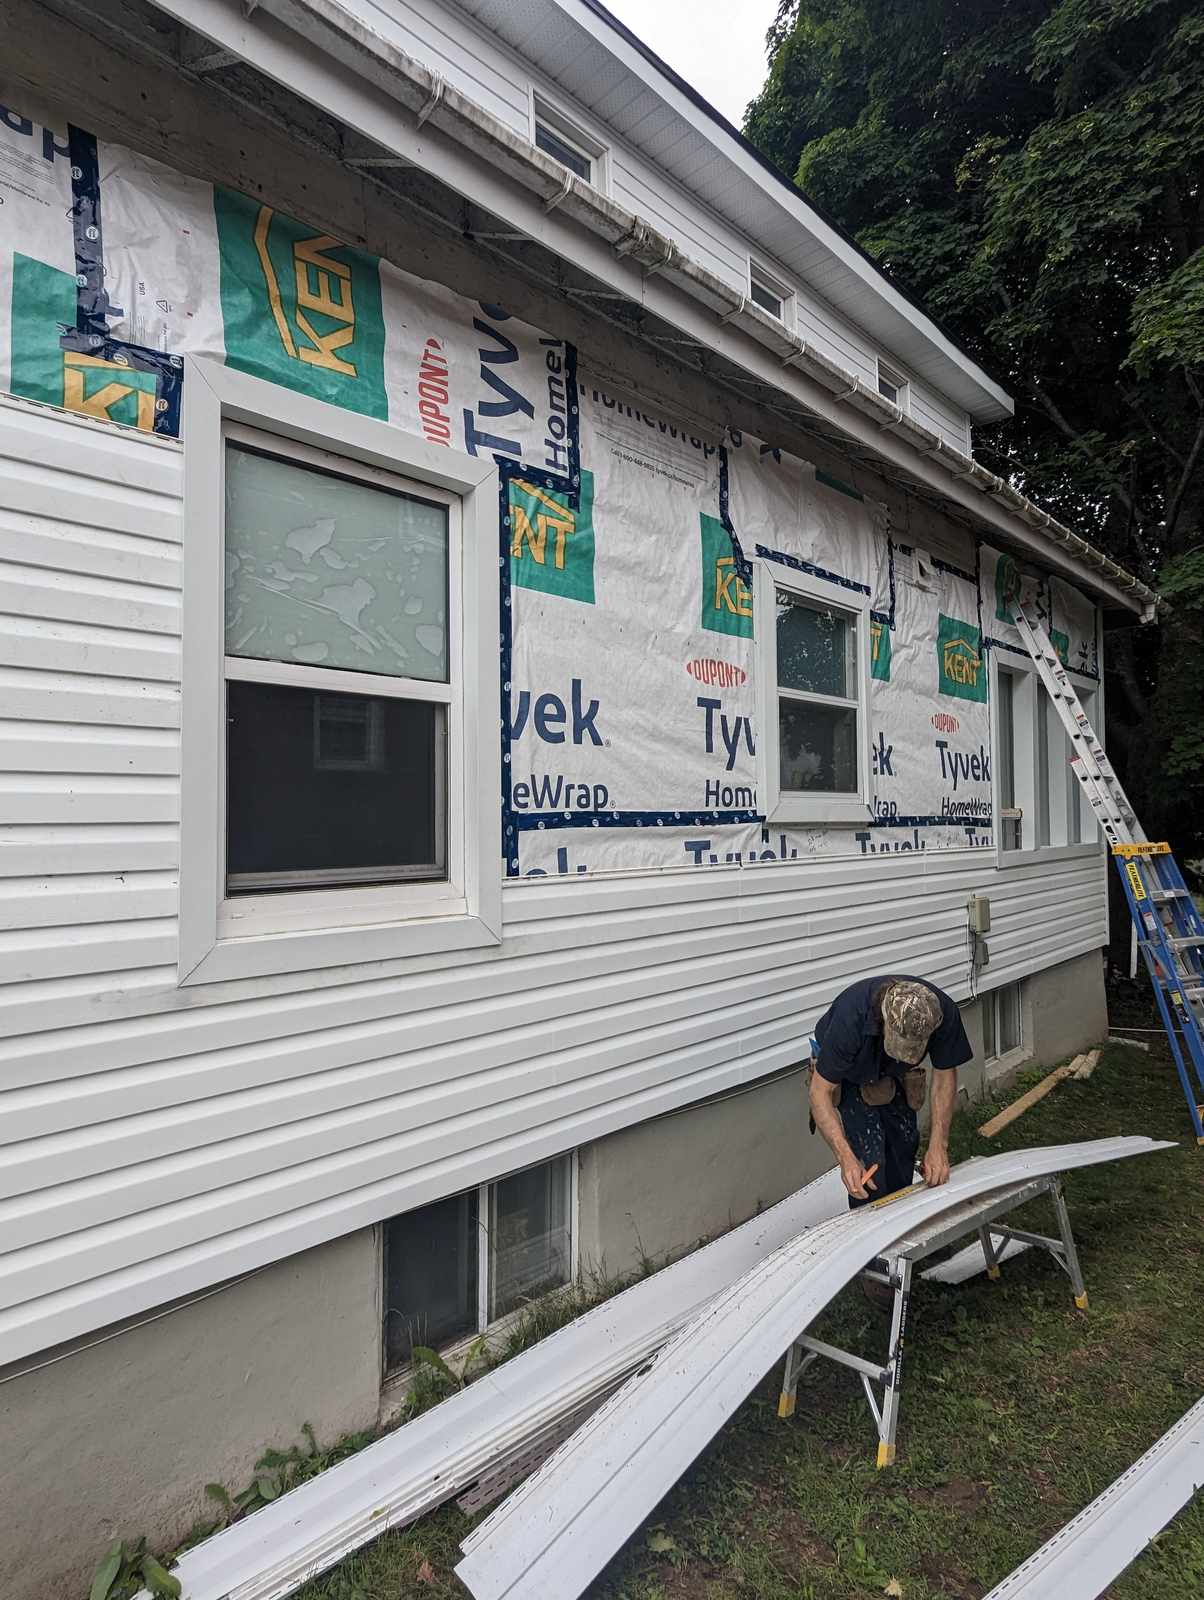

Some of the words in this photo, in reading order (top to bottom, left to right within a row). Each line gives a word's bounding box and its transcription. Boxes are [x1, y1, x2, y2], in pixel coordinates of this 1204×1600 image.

[463, 300, 534, 457] Tyv
[539, 338, 568, 473] Home
[509, 504, 576, 570] NT
[692, 658, 742, 688] DUPONT
[933, 712, 958, 733] DUPONT
[936, 740, 991, 791] Tyvek
[513, 774, 609, 811] eWrap
[705, 779, 757, 808] Hom
[874, 795, 898, 816] rap
